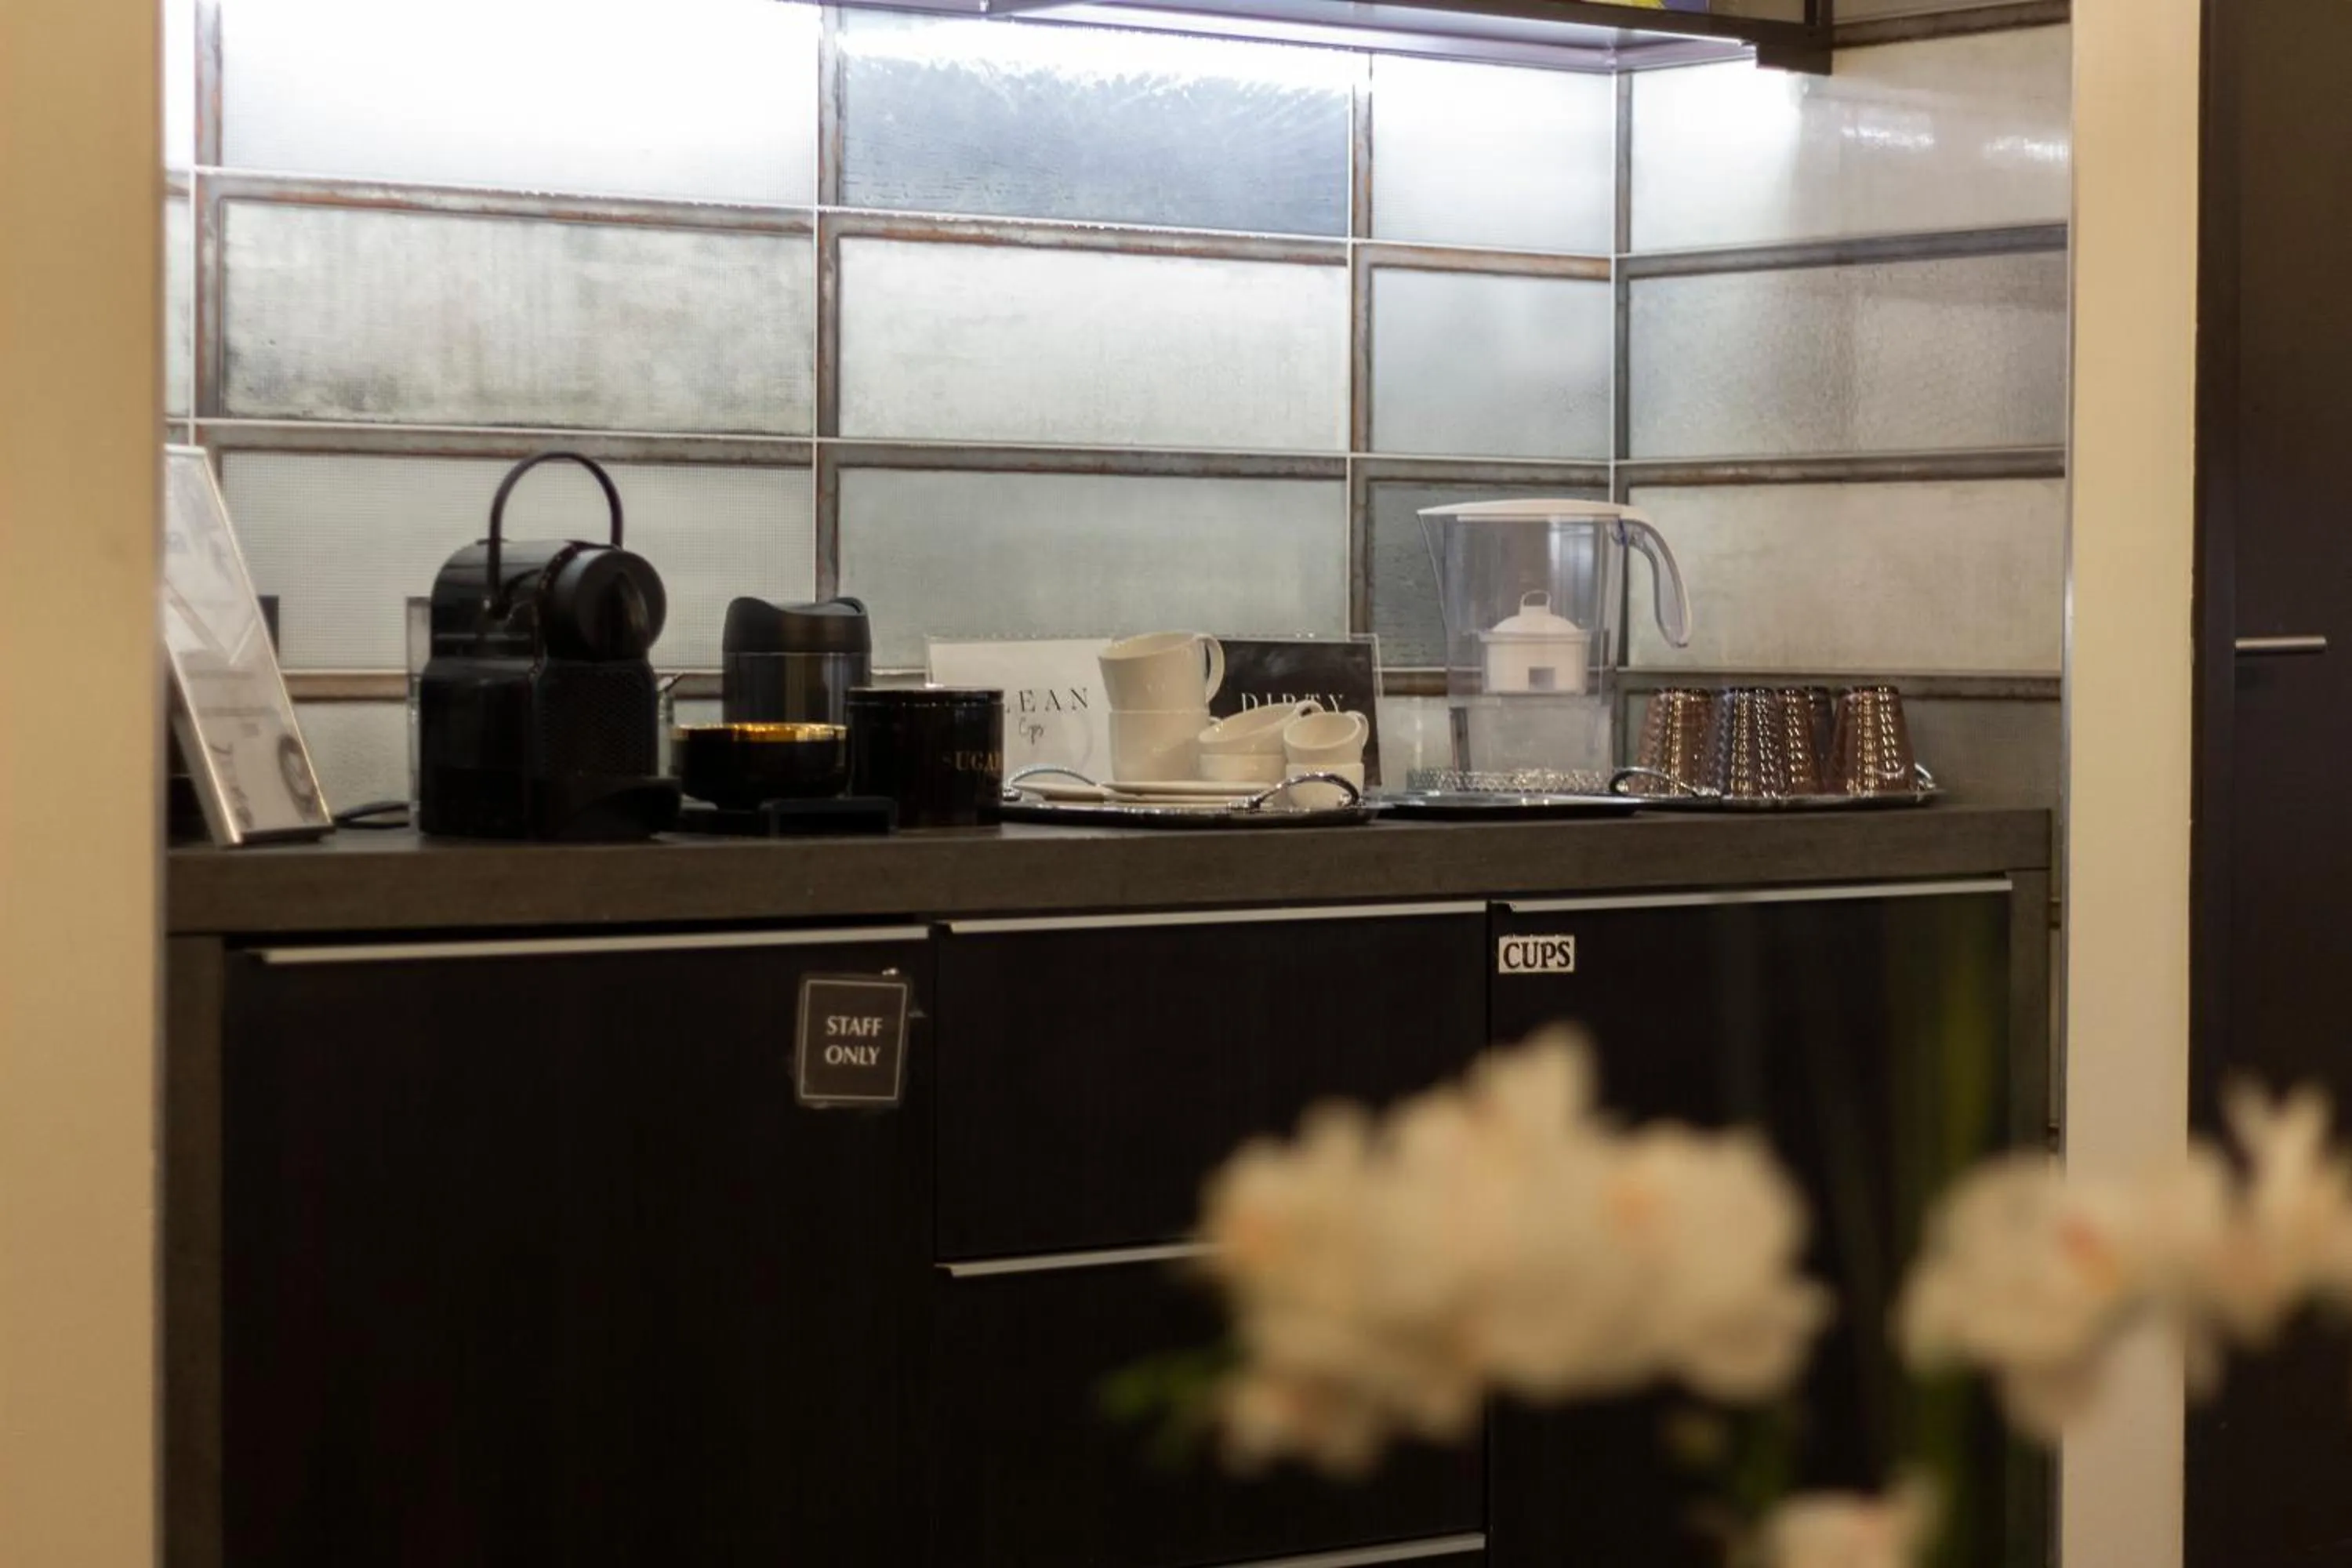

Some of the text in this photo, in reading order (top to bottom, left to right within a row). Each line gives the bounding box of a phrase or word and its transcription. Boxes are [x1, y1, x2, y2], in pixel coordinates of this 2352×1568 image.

[1006, 688, 1088, 713] EAN
[1503, 940, 1570, 969] CUPS
[826, 1015, 884, 1037] STAFF
[825, 1044, 881, 1065] ONLY
